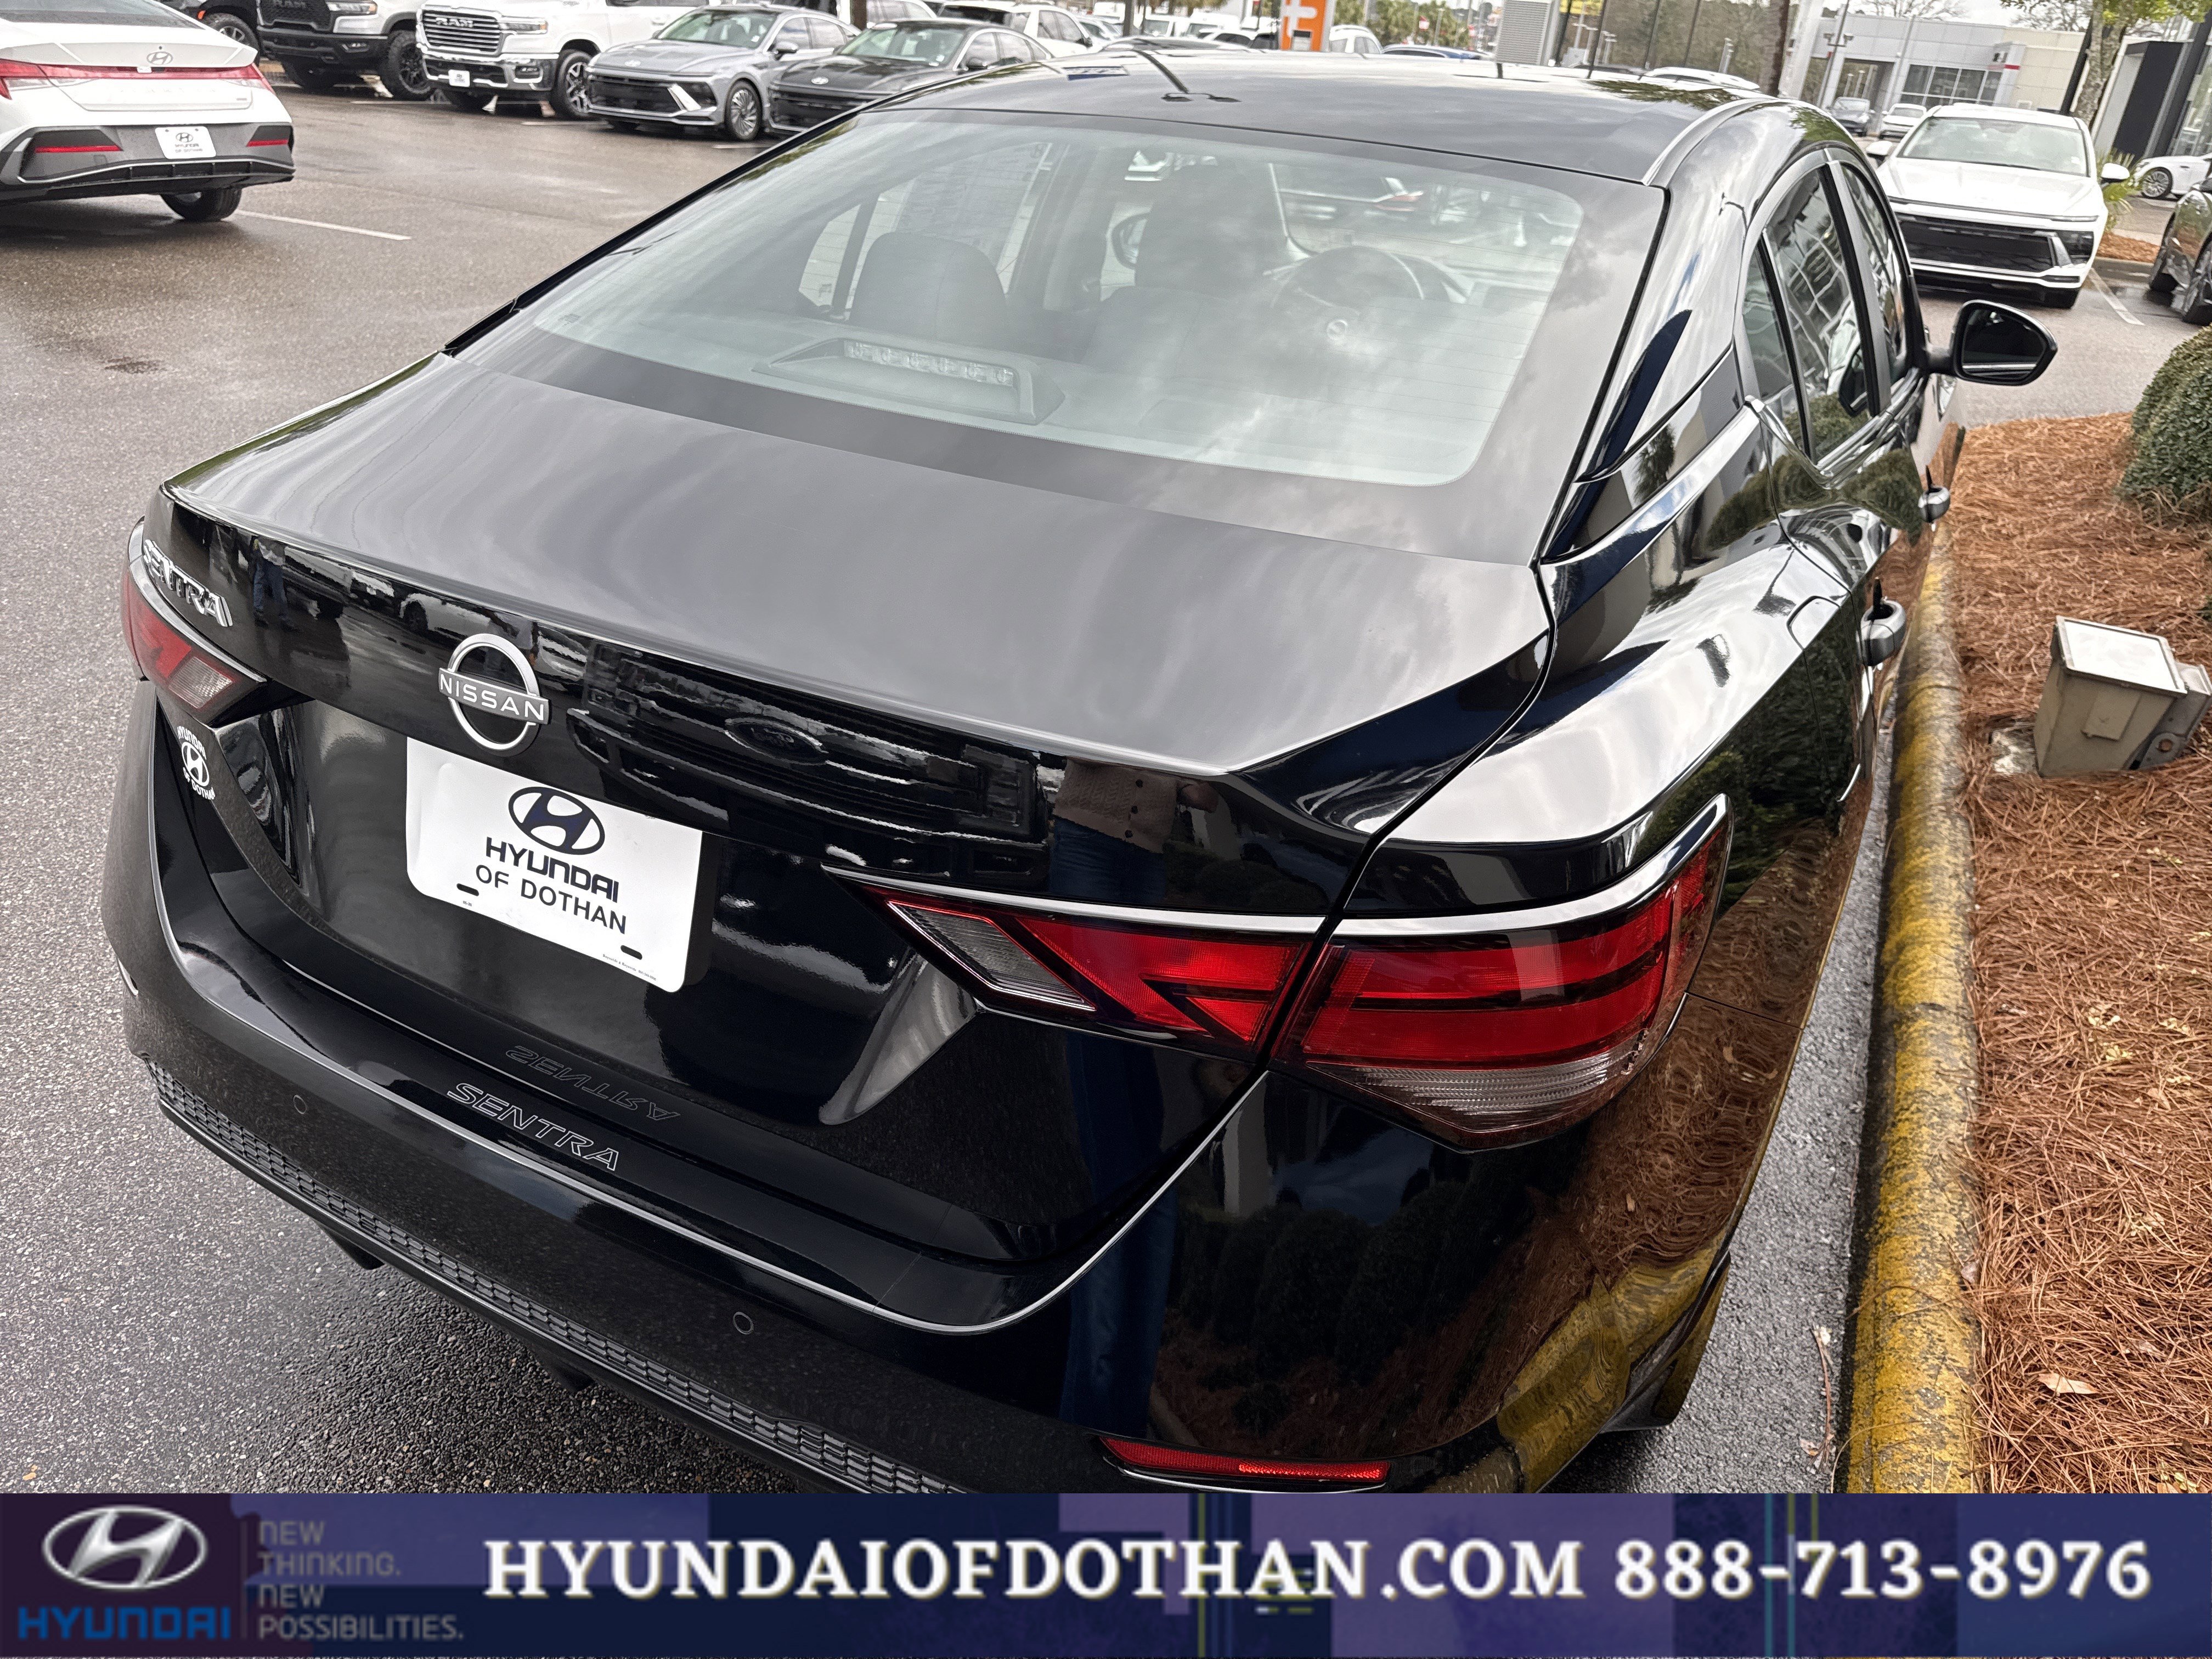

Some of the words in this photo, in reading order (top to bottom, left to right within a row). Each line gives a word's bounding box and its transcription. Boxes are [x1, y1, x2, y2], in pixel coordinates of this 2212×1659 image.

[436, 17, 473, 27] RAM
[143, 539, 233, 627] SENTRA
[440, 674, 544, 721] NISSAN
[177, 725, 207, 760] HYUNDAI
[191, 779, 216, 800] DOTHAN
[486, 837, 619, 903] HYUNDAI
[476, 865, 509, 888] OF
[521, 878, 626, 935] DOTHAN
[446, 1082, 619, 1172] SENTRA
